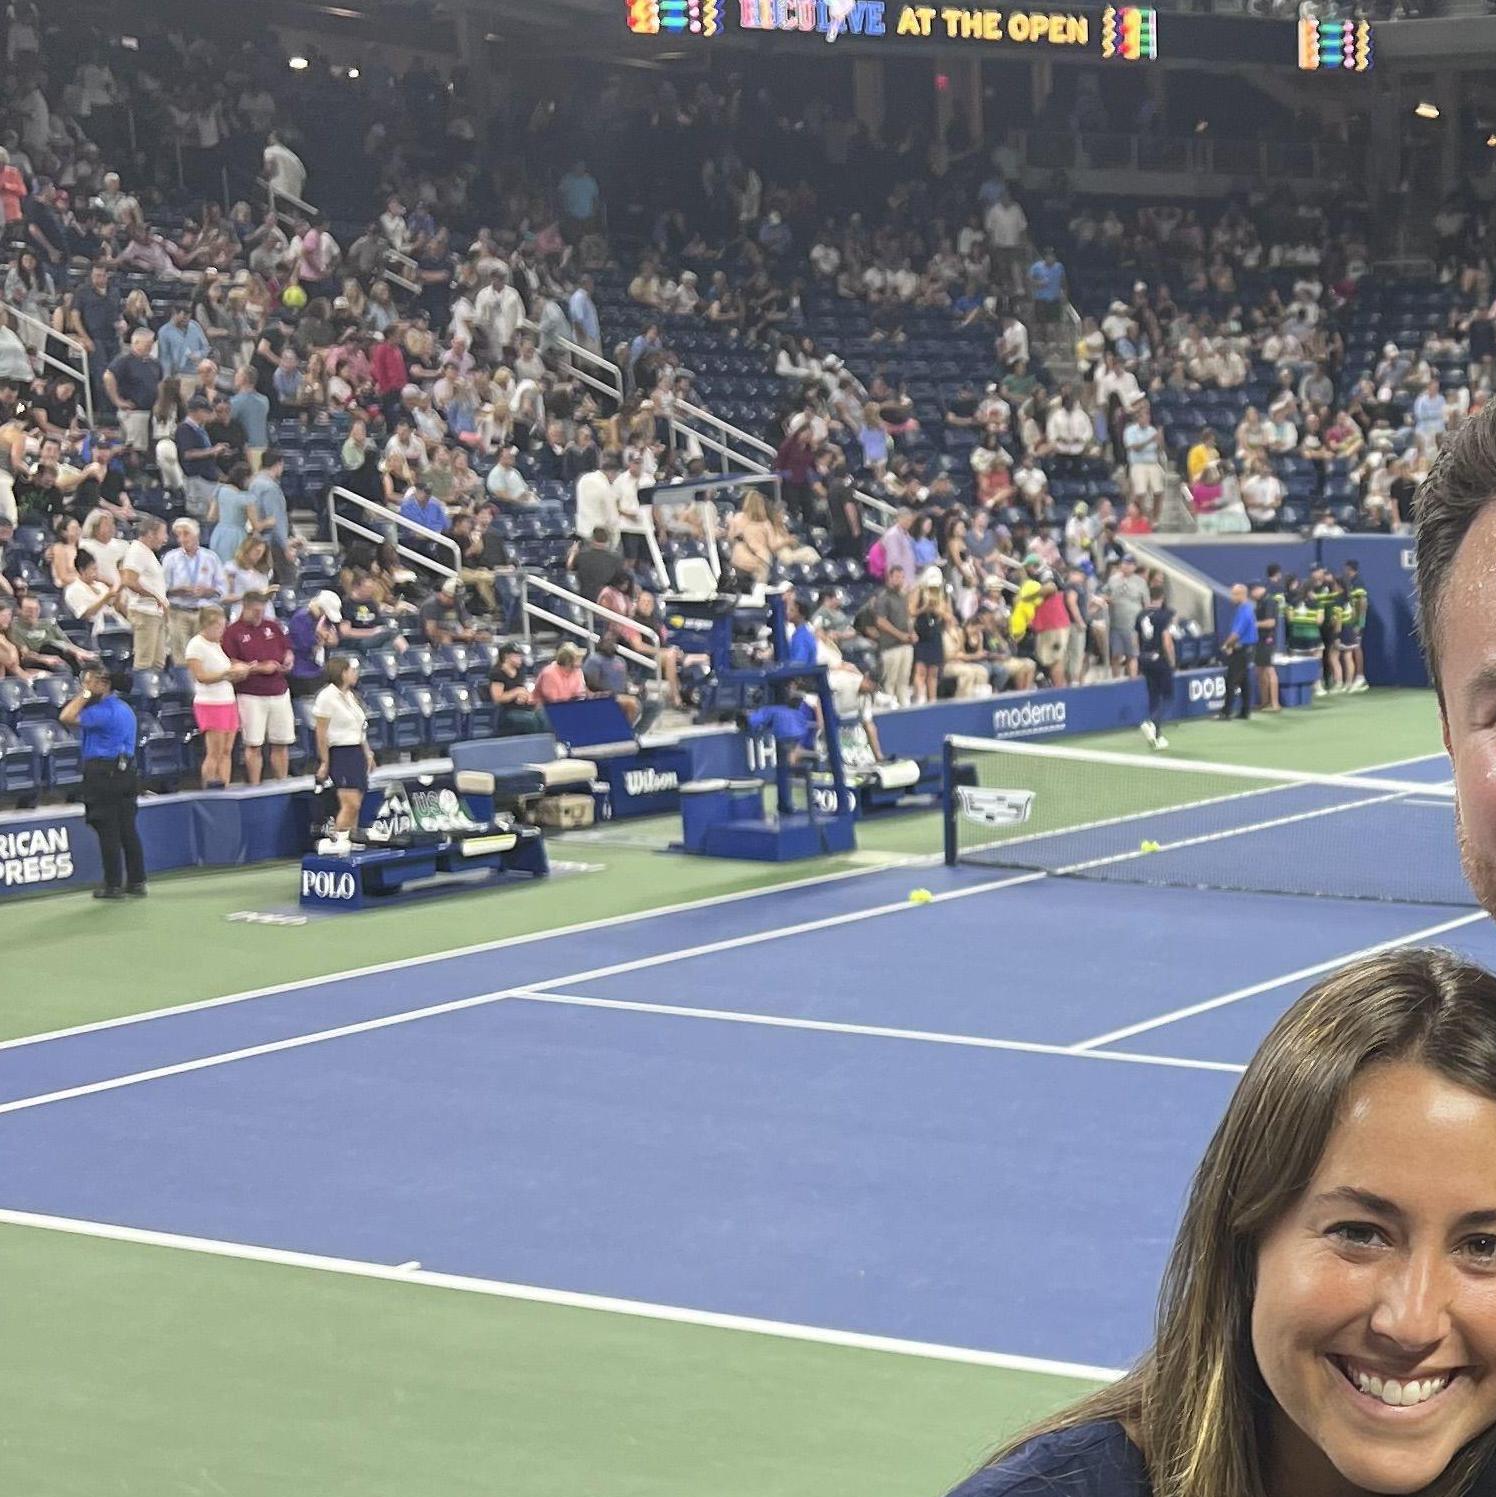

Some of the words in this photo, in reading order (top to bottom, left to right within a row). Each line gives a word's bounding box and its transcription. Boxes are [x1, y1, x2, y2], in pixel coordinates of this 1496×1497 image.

[896, 6, 936, 36] AT
[941, 7, 1003, 41] THE
[1007, 13, 1088, 44] OPEN
[624, 769, 680, 796] Wilson
[302, 870, 356, 900] POLO
